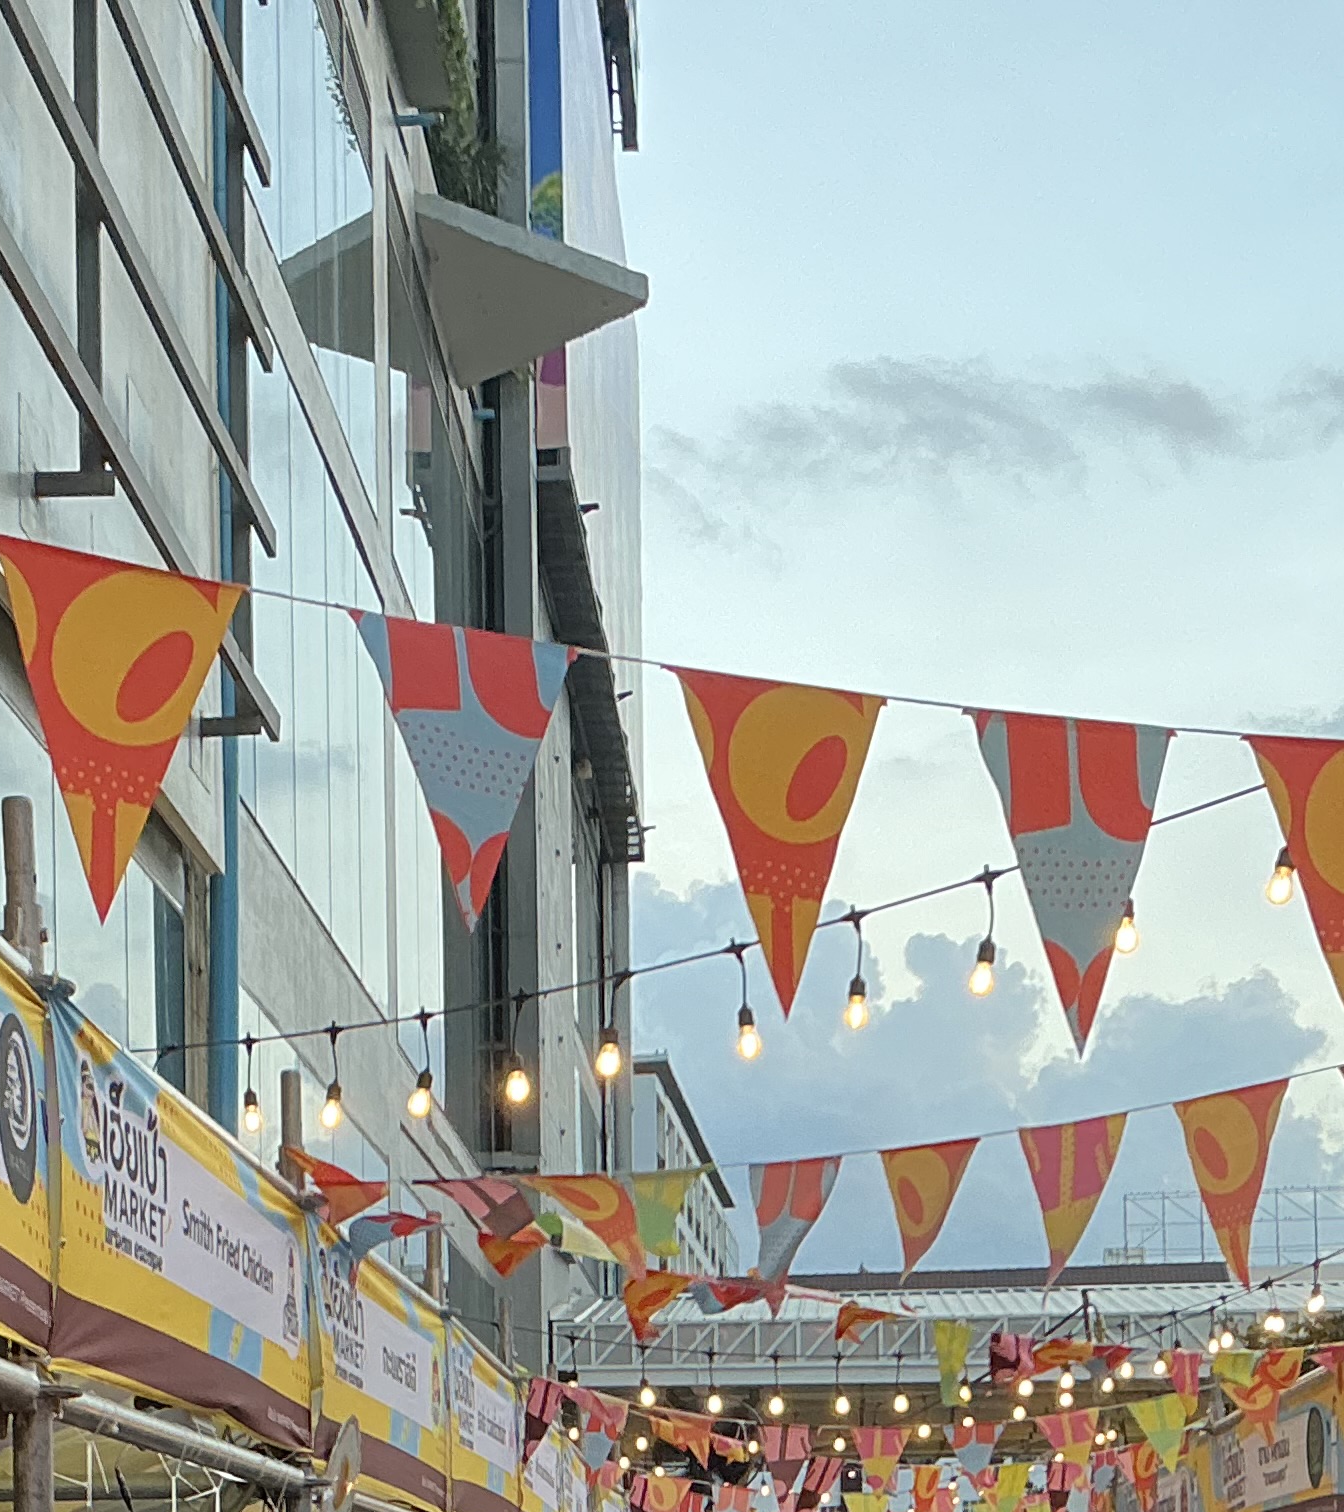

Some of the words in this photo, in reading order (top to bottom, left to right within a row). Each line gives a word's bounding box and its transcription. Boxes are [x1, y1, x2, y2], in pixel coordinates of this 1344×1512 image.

[104, 1170, 167, 1248] MARKET
[182, 1198, 214, 1256] Smith
[216, 1223, 240, 1271] Fried
